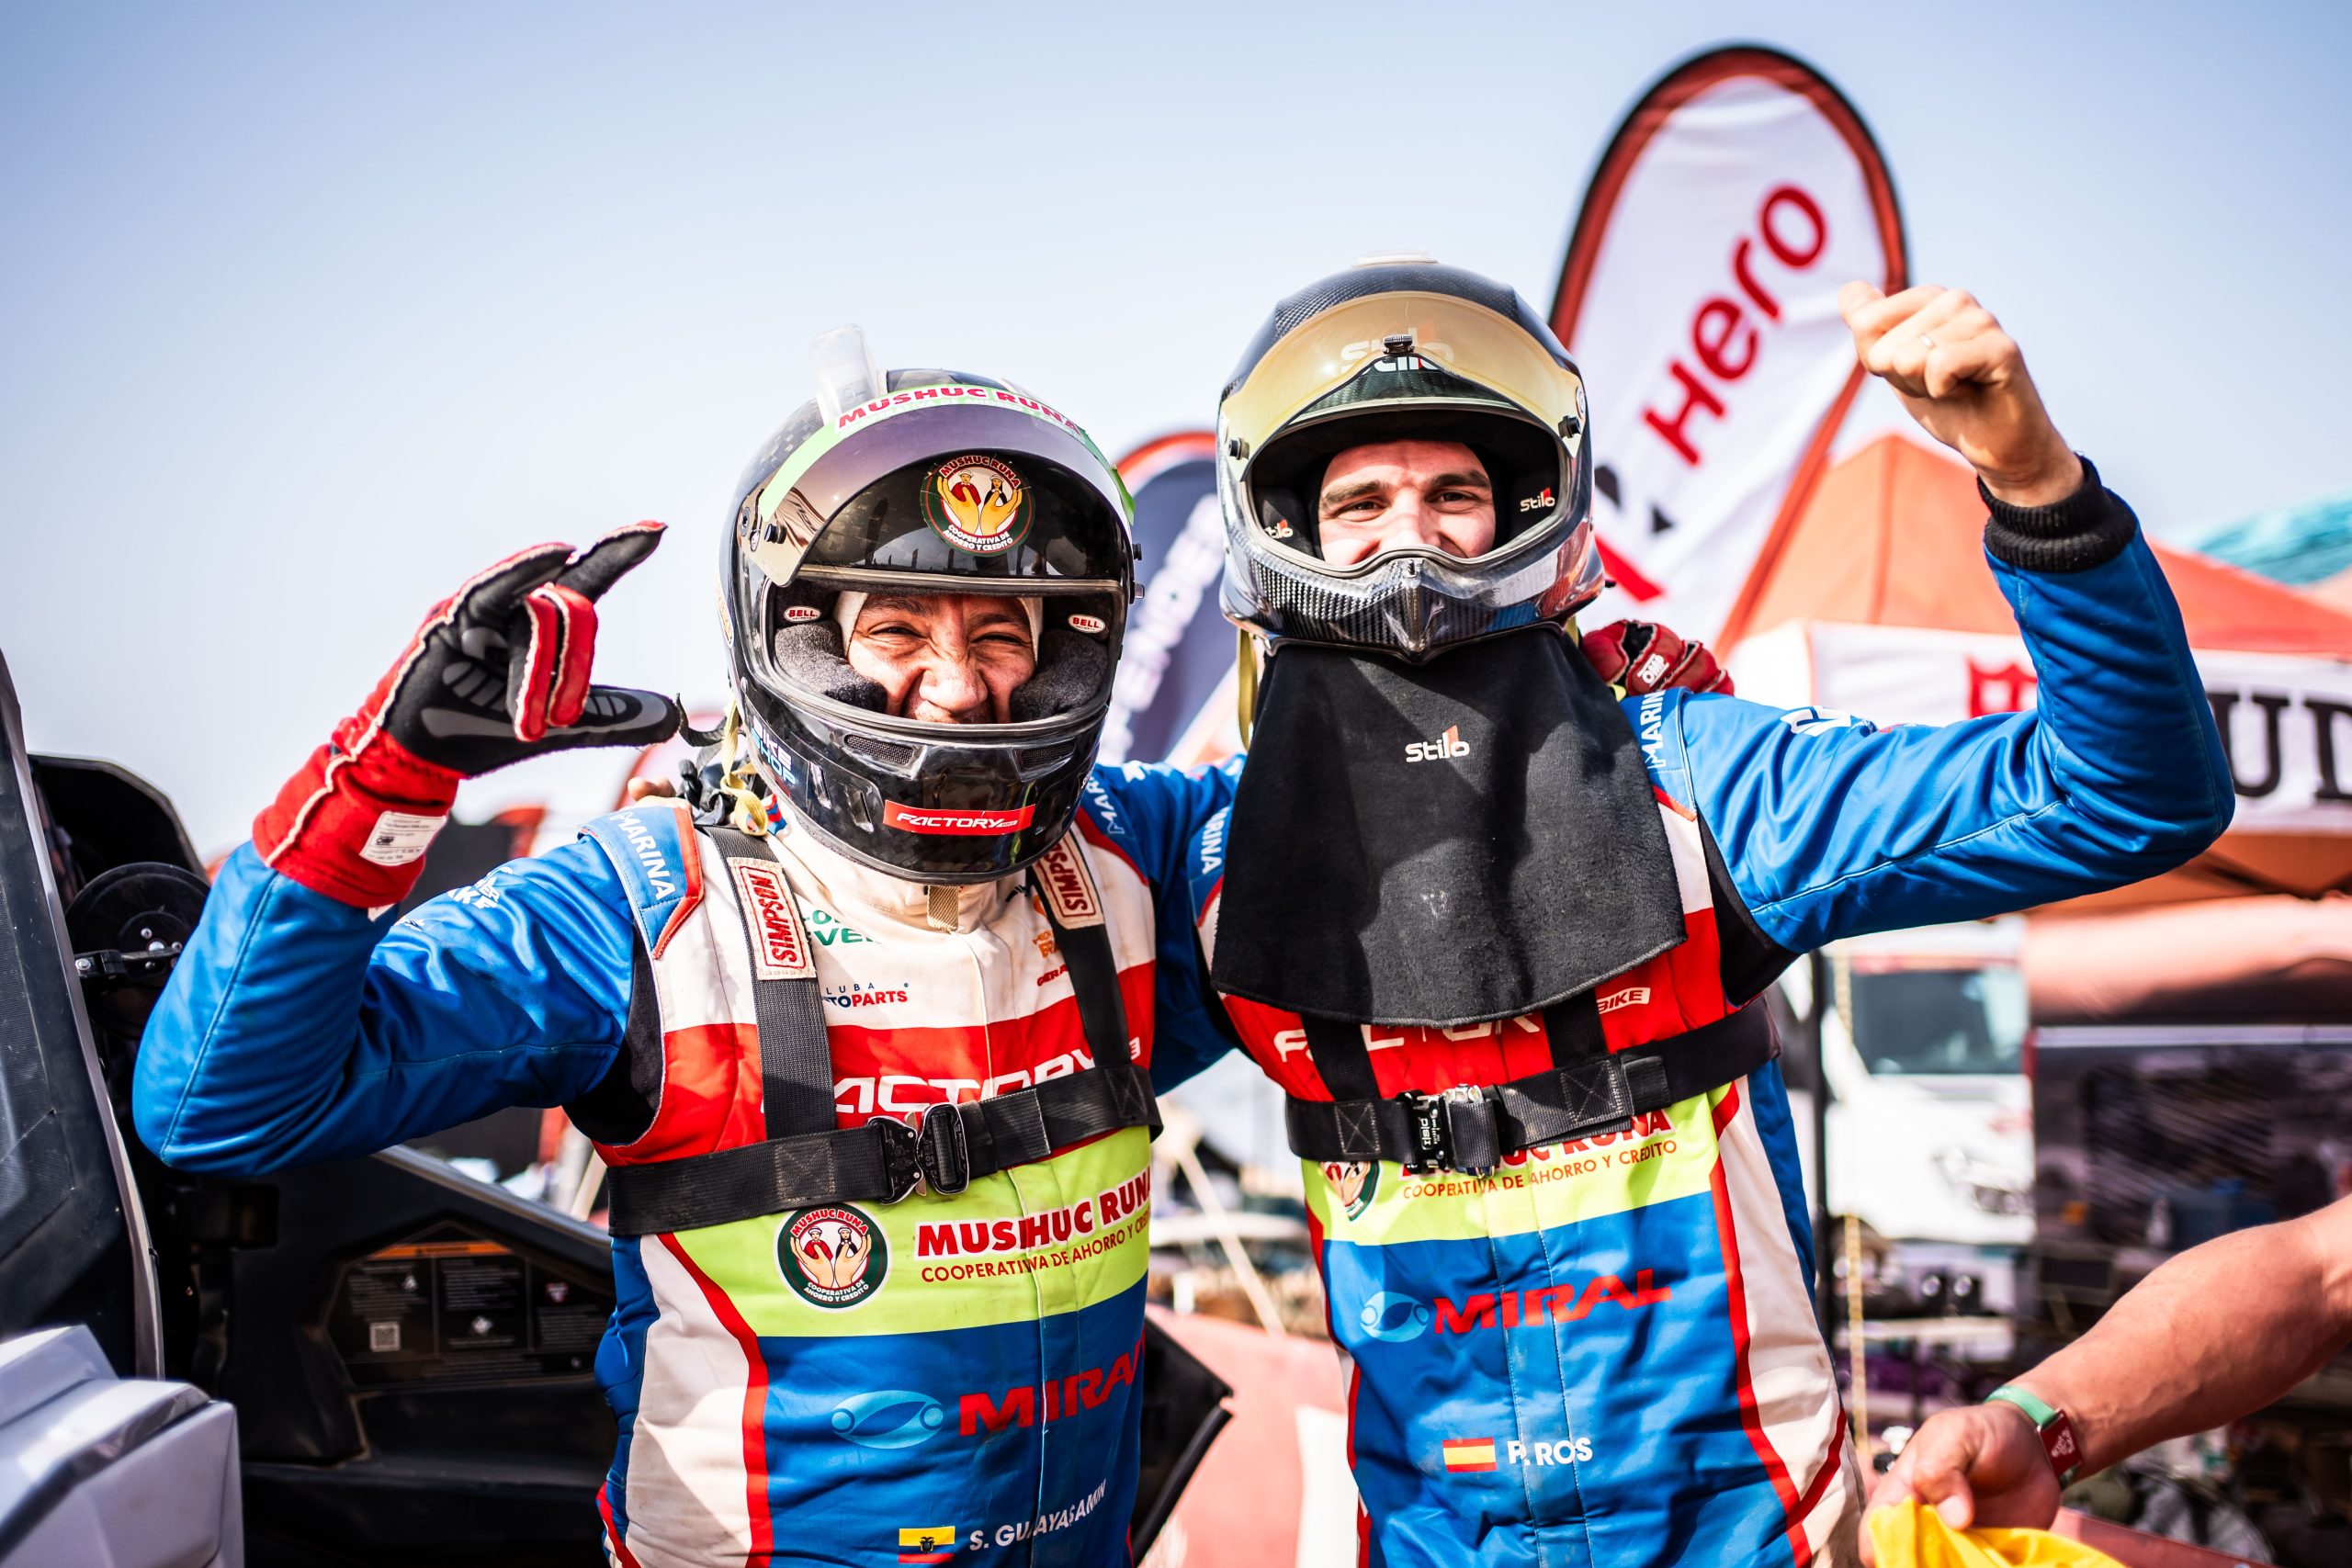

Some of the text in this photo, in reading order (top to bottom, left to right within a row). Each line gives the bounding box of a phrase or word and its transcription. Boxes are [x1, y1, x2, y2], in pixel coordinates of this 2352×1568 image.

[1643, 185, 1826, 467] Hero
[838, 387, 987, 429] MUSHUC
[996, 390, 1082, 436] RUNA
[939, 455, 1022, 489] MUSHUC RUNA
[1519, 488, 1555, 513] stilo
[943, 530, 975, 550] AHORRO
[982, 537, 1013, 551] CREDITO
[947, 525, 1011, 544] COOPERATIVA DE
[788, 609, 816, 617] BELL
[1072, 616, 1100, 628] BELL
[752, 716, 792, 771] BIKE
[1405, 726, 1470, 762] stilo
[896, 812, 1005, 829] FACTORY
[609, 809, 677, 901] MARINA
[1043, 842, 1088, 912] SIMPS
[749, 874, 797, 964] SIMPSON
[1403, 1178, 1498, 1199] COOPERATIVA
[1502, 1174, 1525, 1190] DE
[1530, 1158, 1597, 1185] AHORRO
[1602, 1155, 1611, 1169] Y
[1619, 1140, 1678, 1166] CREDITO
[790, 1208, 869, 1237] MUSHUC RUNA
[918, 1201, 1093, 1257] MUSHUC
[922, 1256, 1049, 1283] COOPERATIVA
[1050, 1250, 1070, 1269] DE
[1070, 1229, 1126, 1265] AHORRO
[1125, 1225, 1134, 1241] Y
[803, 1286, 833, 1303] AHORRO
[841, 1283, 870, 1303] CREDITO
[807, 1279, 865, 1296] COOPERATIVA DE
[1434, 1268, 1672, 1335] MIRAL
[1535, 1437, 1593, 1467] ROS
[969, 1529, 989, 1551] S.
